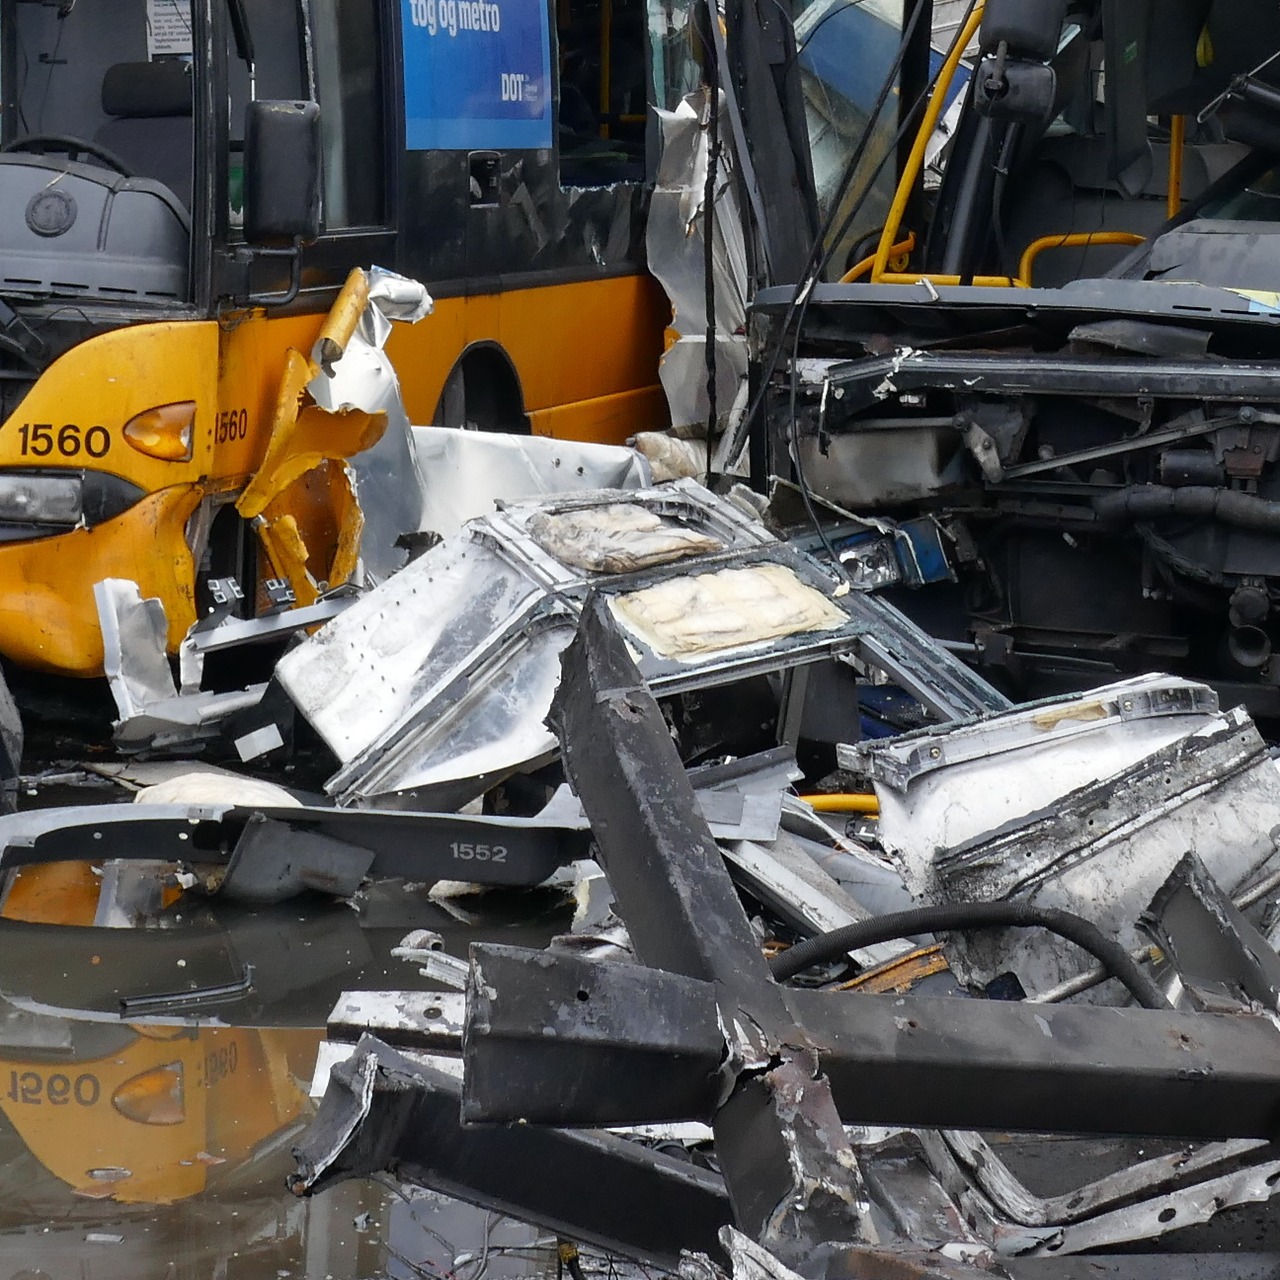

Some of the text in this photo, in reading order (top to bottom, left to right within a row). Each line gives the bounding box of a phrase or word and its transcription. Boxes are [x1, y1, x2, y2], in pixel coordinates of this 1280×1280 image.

[501, 73, 524, 101] DOT
[18, 423, 111, 458] 1560
[214, 408, 248, 444] 1560
[450, 842, 508, 862] 1552
